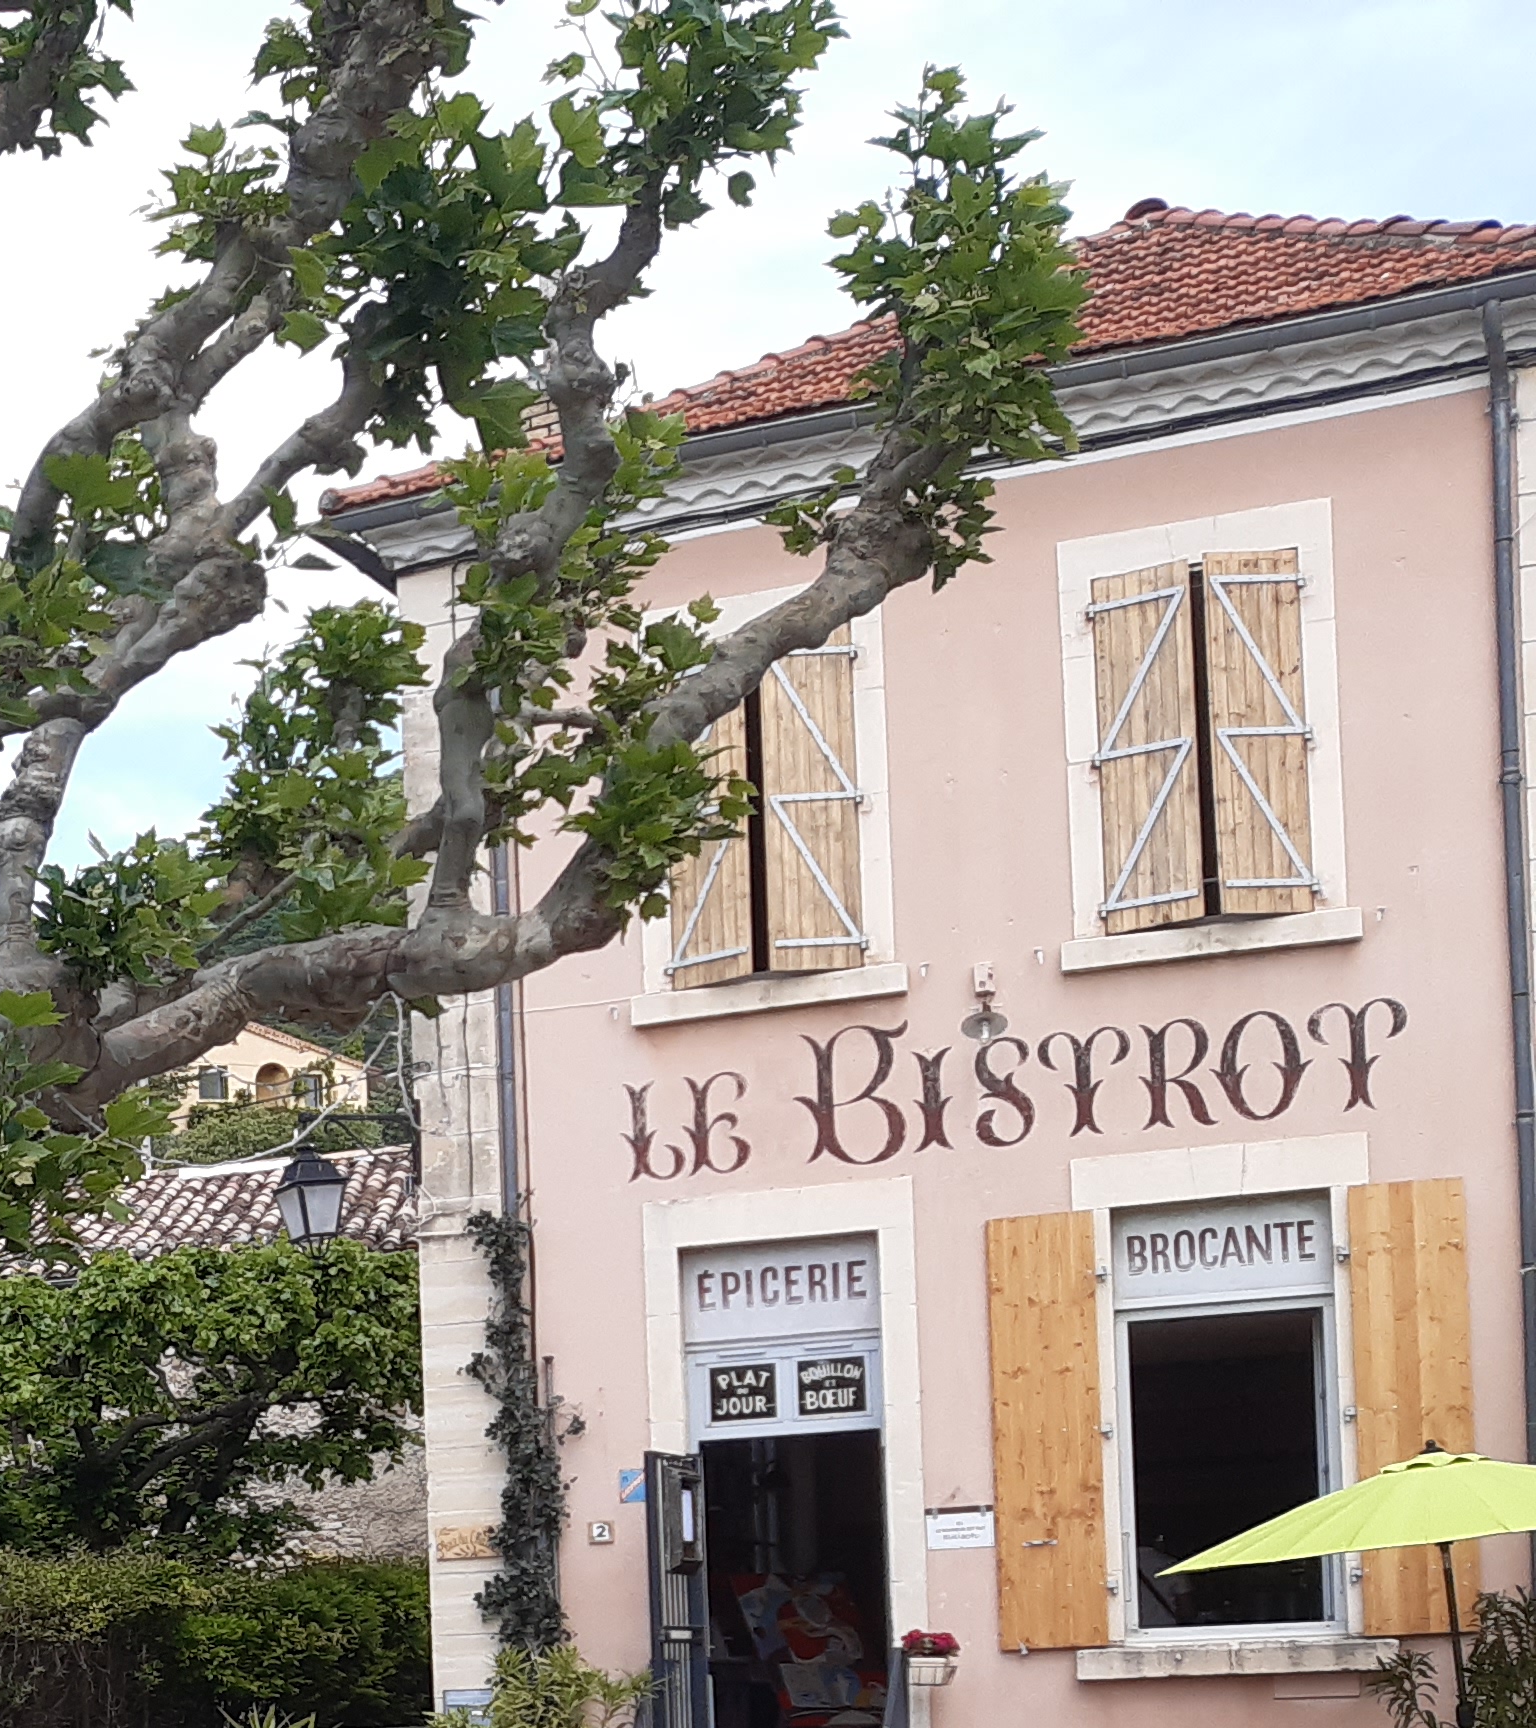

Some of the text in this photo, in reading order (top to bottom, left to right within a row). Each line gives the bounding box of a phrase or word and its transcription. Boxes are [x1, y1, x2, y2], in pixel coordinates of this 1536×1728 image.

[1126, 1219, 1317, 1277] BROCANTE
[696, 1259, 868, 1312] ÉPICERIE
[716, 1369, 771, 1390] PLAT
[800, 1363, 863, 1384] BOUILLON
[715, 1395, 768, 1416] JOUR
[595, 1525, 607, 1538] 2
